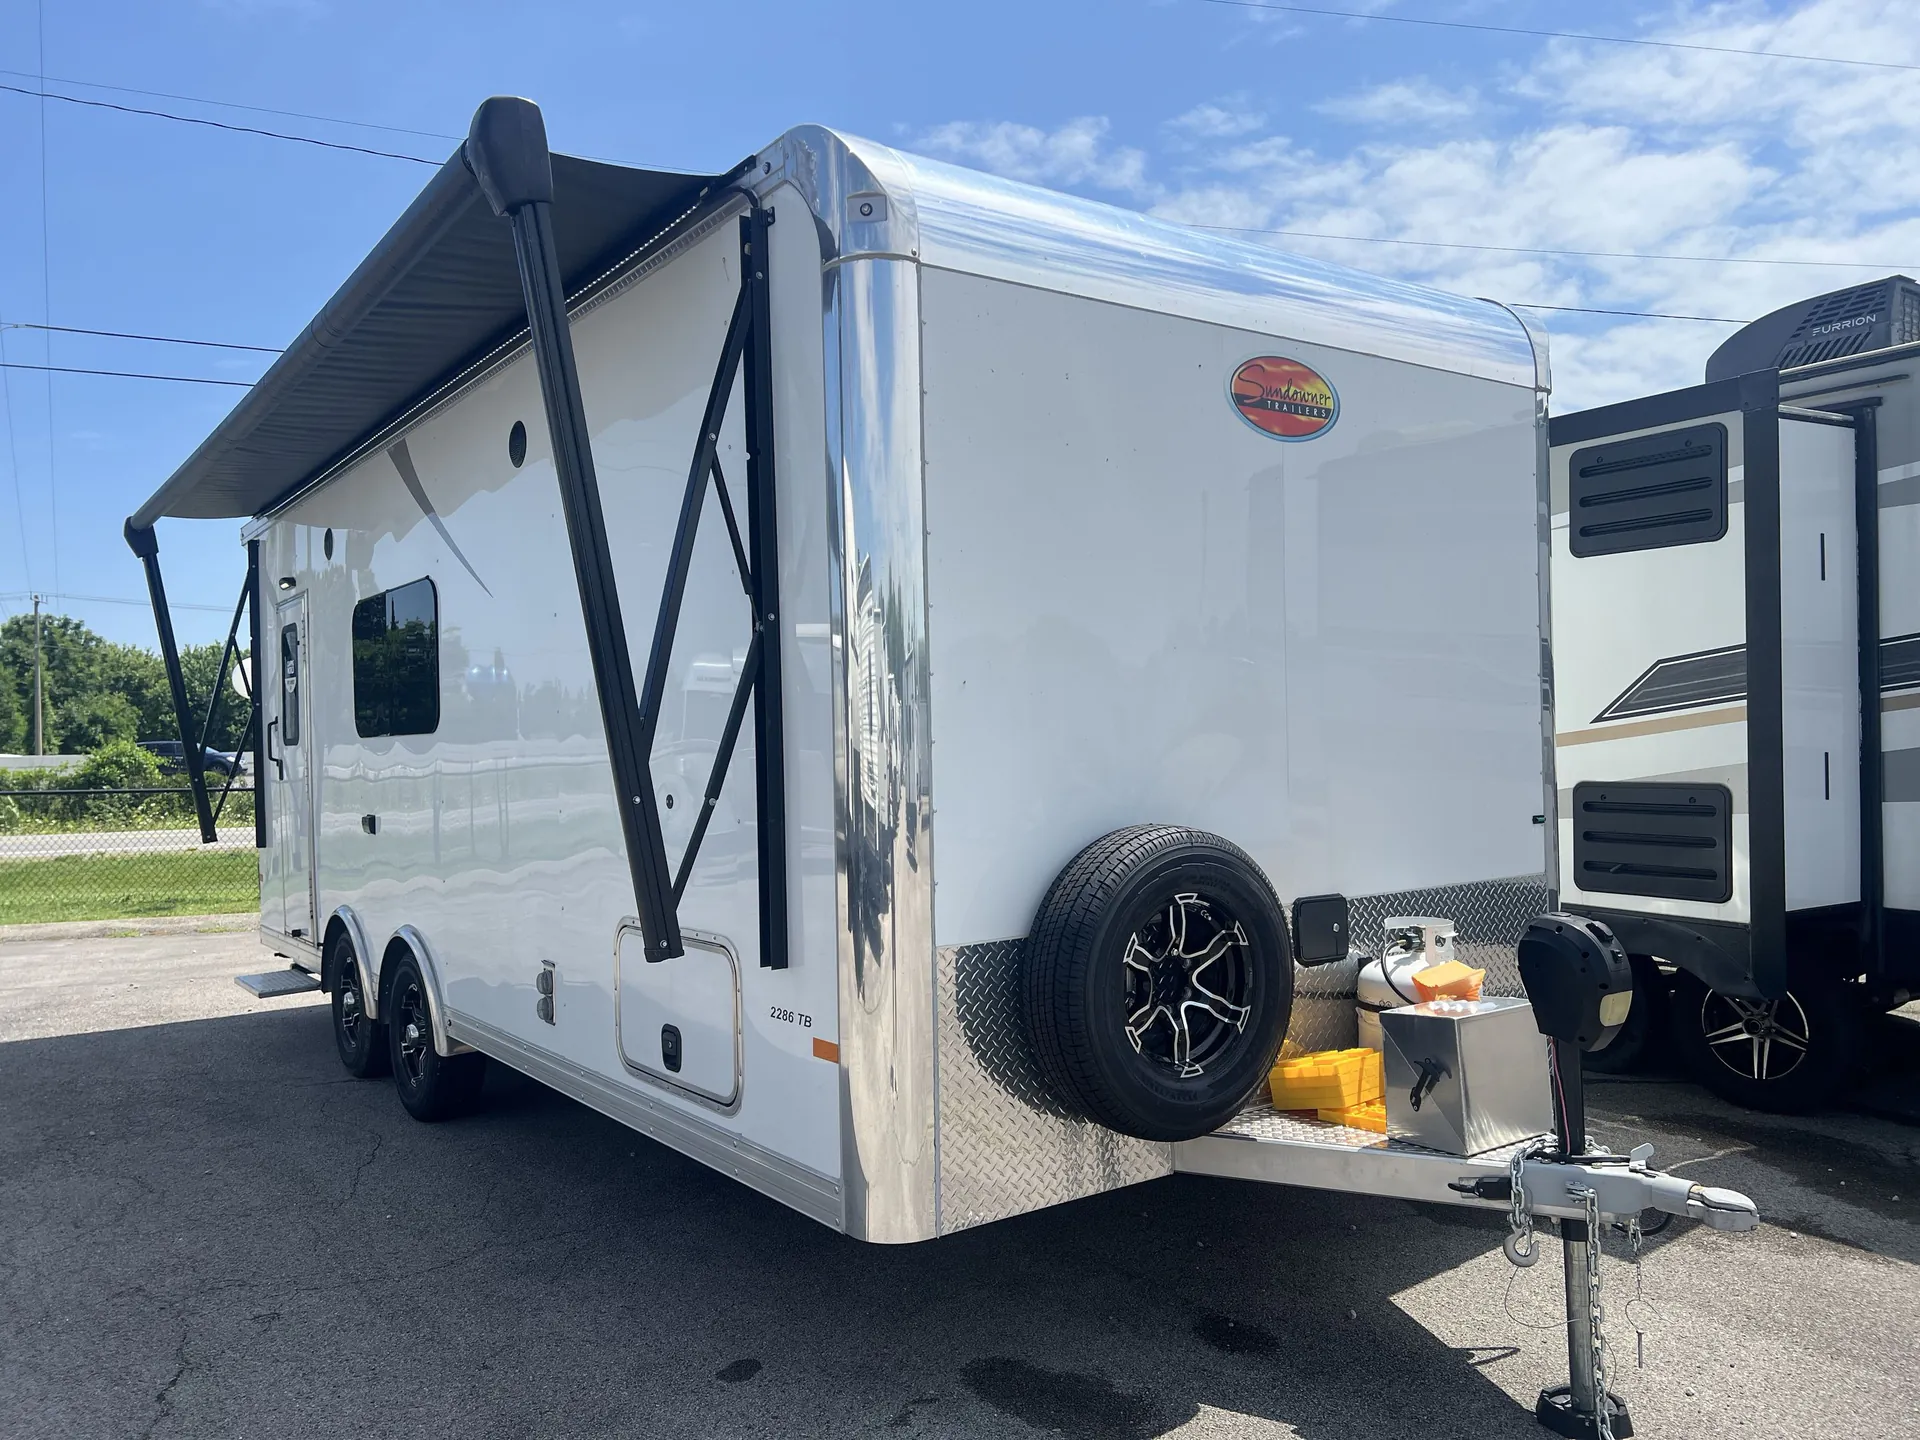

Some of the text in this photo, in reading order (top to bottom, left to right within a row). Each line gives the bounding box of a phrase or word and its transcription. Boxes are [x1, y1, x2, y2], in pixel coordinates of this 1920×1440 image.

[1812, 314, 1876, 336] FURRION
[1238, 364, 1331, 406] Sundowner
[1267, 400, 1326, 417] TRAILERS
[770, 1006, 812, 1028] 2286 TB
